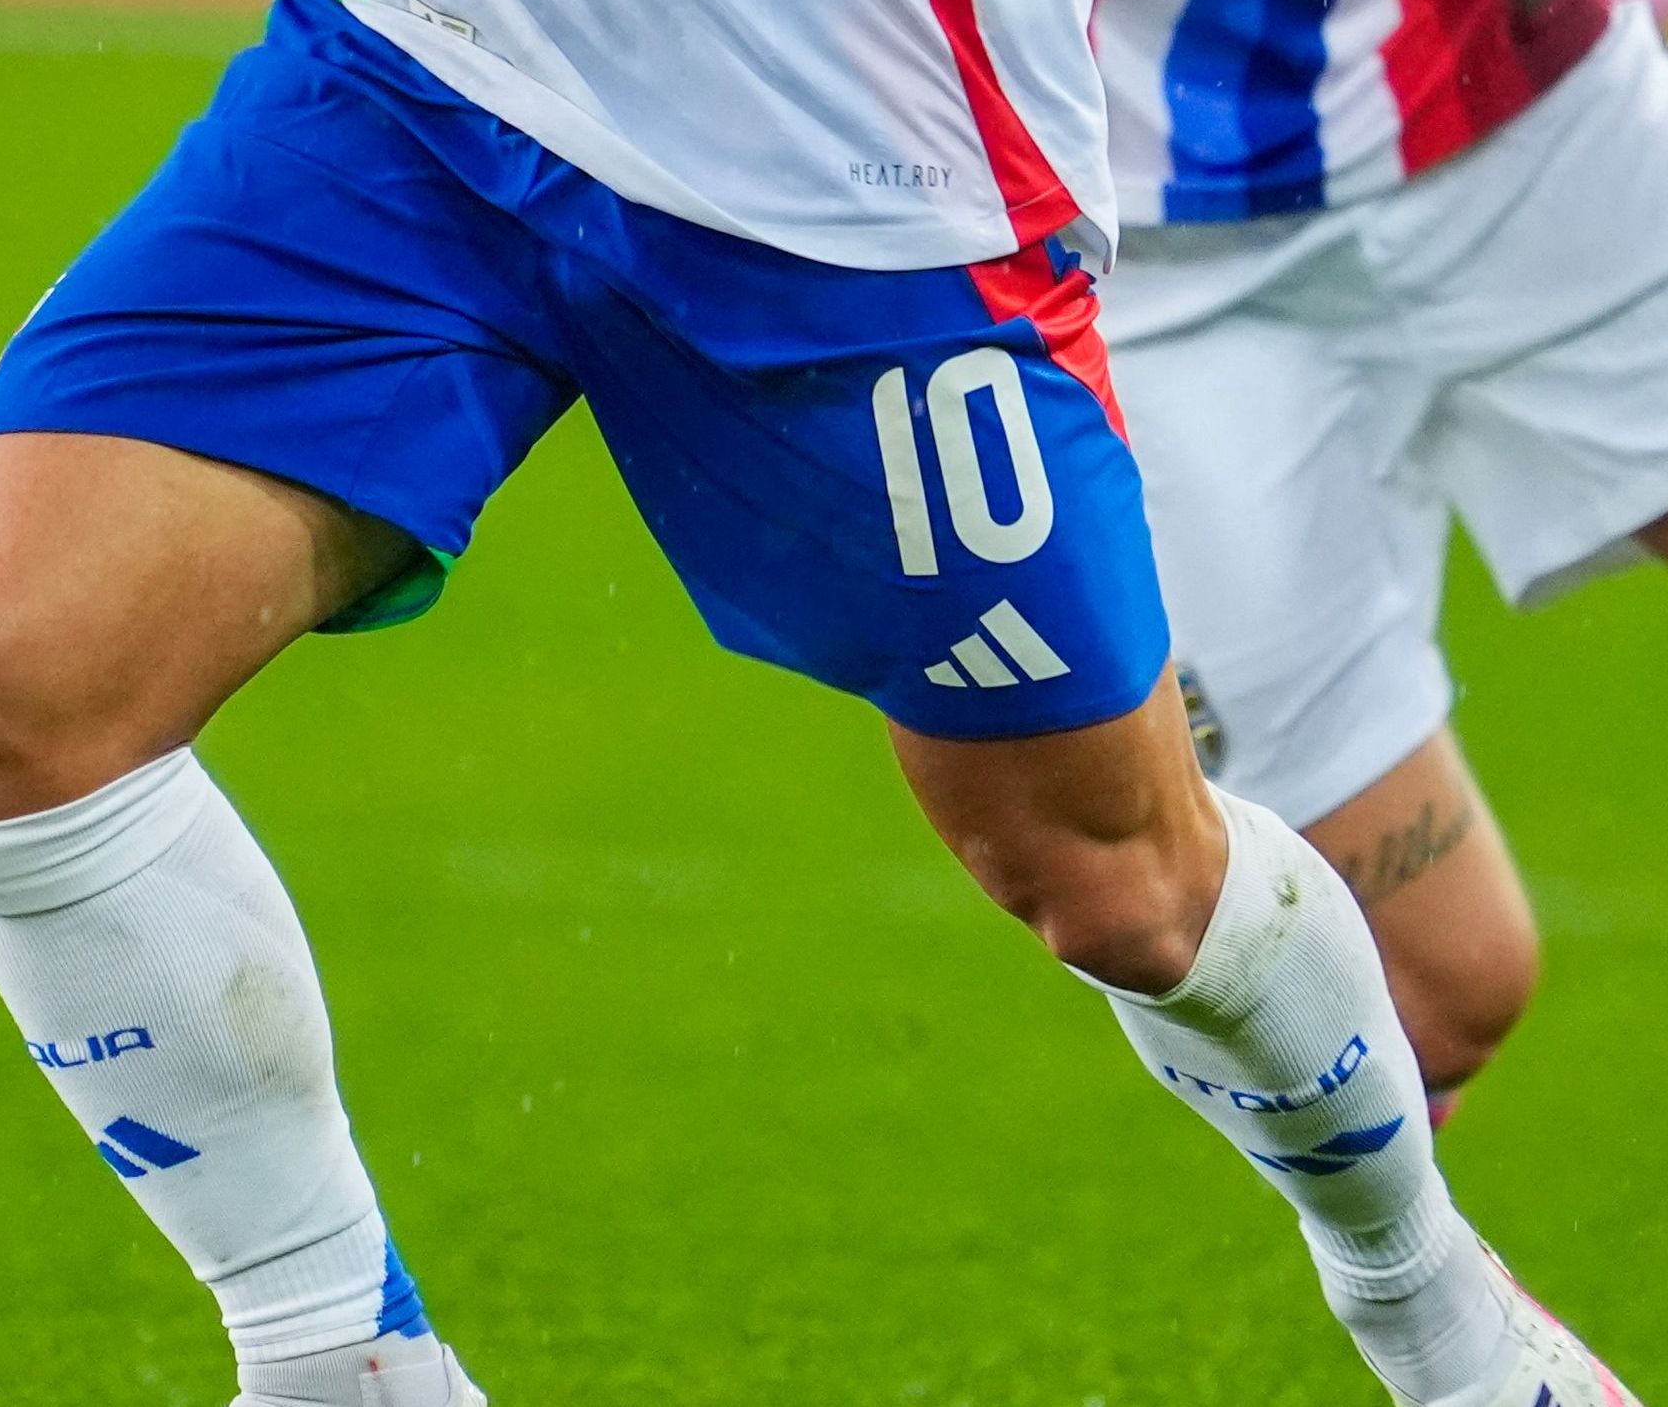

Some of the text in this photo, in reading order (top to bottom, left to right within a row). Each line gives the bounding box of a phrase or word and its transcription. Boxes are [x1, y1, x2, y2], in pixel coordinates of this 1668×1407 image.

[849, 161, 952, 189] HEAT.RDY
[872, 346, 1054, 576] 10
[1164, 1034, 1368, 1113] ITALIA
